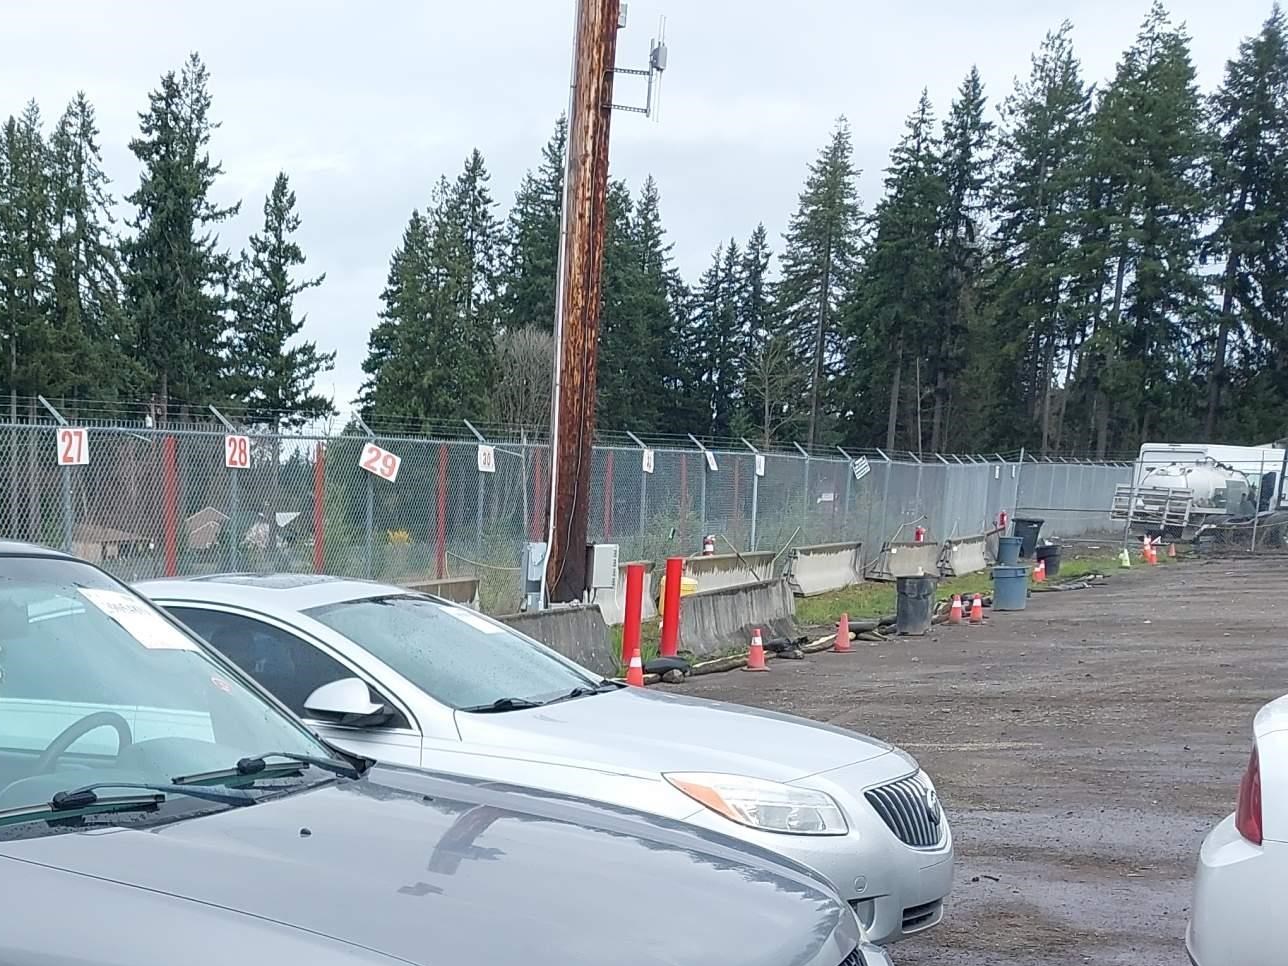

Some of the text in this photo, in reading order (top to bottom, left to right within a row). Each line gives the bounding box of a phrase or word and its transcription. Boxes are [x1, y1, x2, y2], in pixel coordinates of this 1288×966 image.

[61, 430, 83, 463] 27
[228, 437, 248, 466] 28
[363, 446, 396, 477] 29
